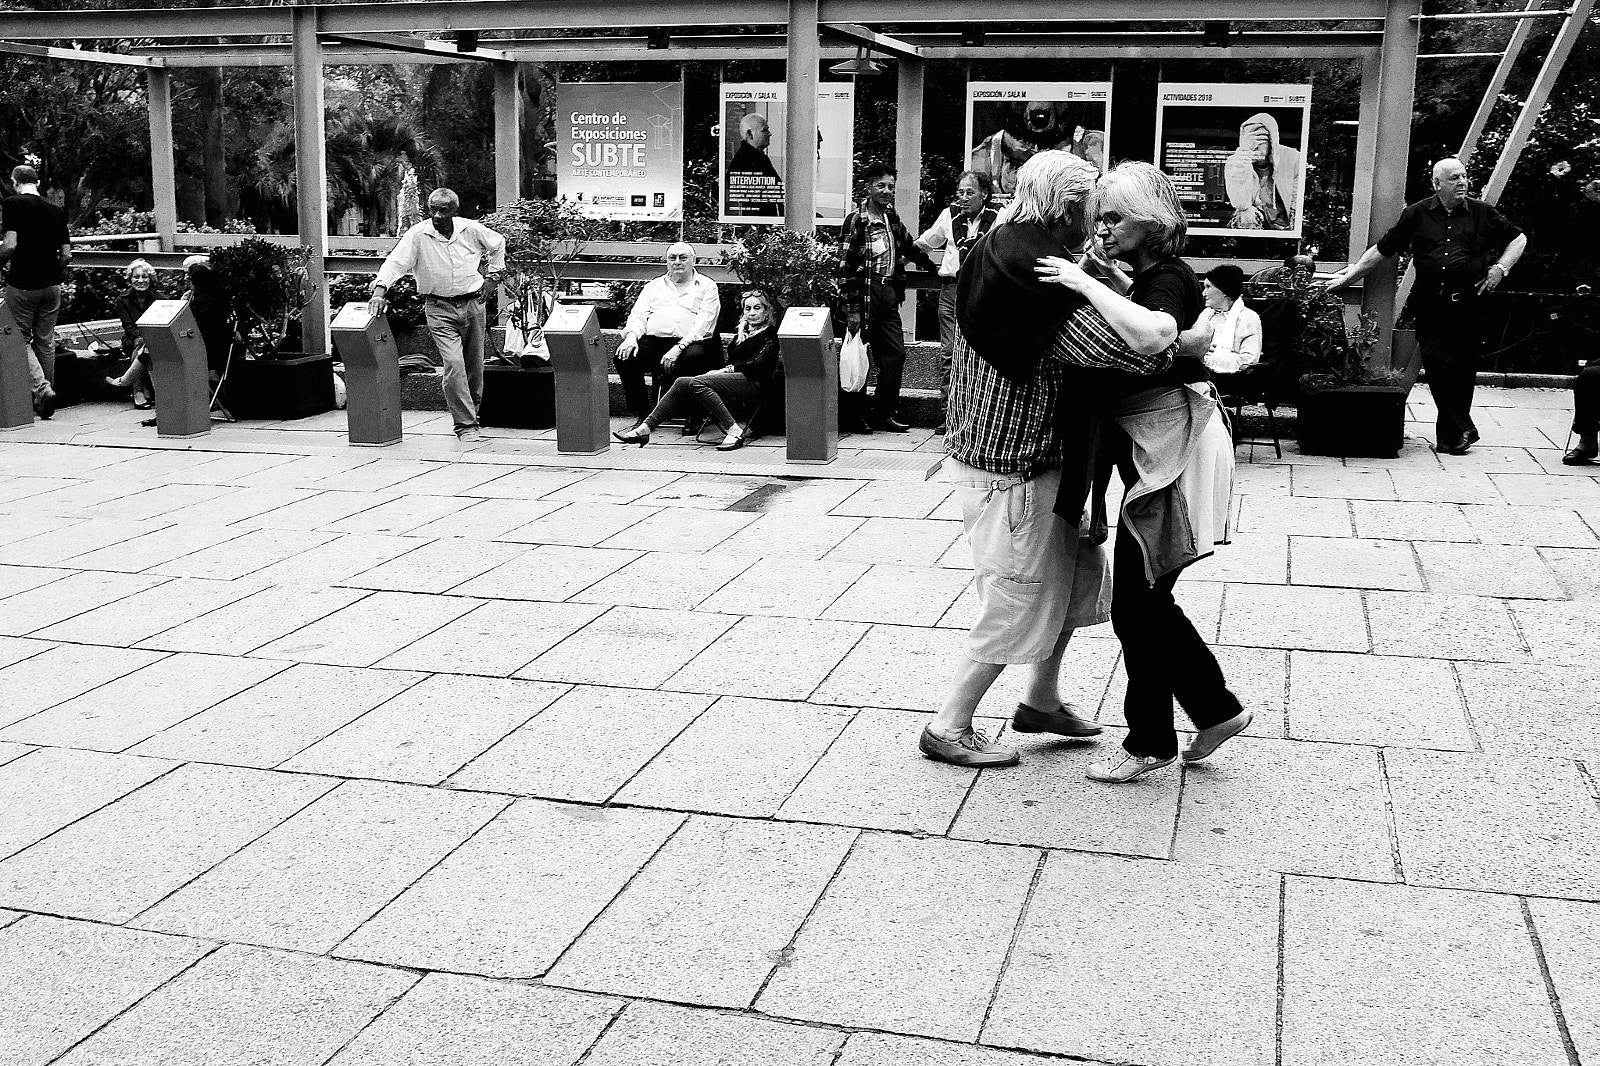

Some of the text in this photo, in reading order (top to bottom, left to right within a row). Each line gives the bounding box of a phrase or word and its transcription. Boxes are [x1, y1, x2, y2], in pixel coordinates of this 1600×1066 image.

[1162, 93, 1197, 102] ACTIVIDADES
[570, 112, 627, 125] Centro de
[571, 127, 647, 142] Exposiciones
[571, 143, 647, 167] SUBTE
[572, 168, 646, 177] ARTE CONTEMPORÁNEO
